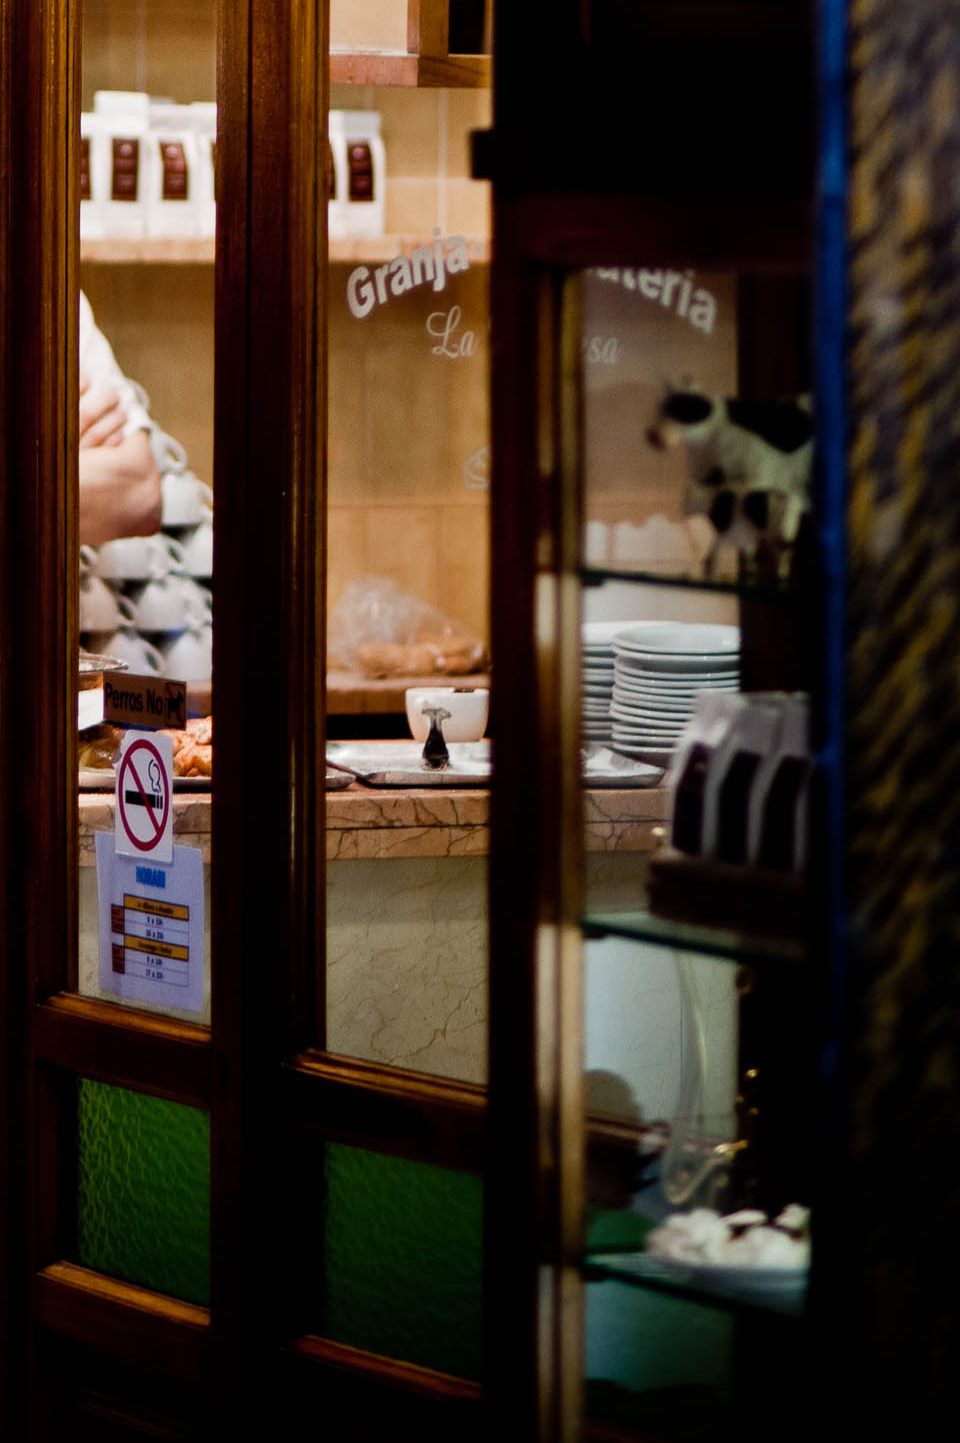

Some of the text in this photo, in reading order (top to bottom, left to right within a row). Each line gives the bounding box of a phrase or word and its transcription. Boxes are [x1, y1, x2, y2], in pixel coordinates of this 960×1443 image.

[426, 306, 475, 358] La
[104, 682, 164, 715] Perros No
